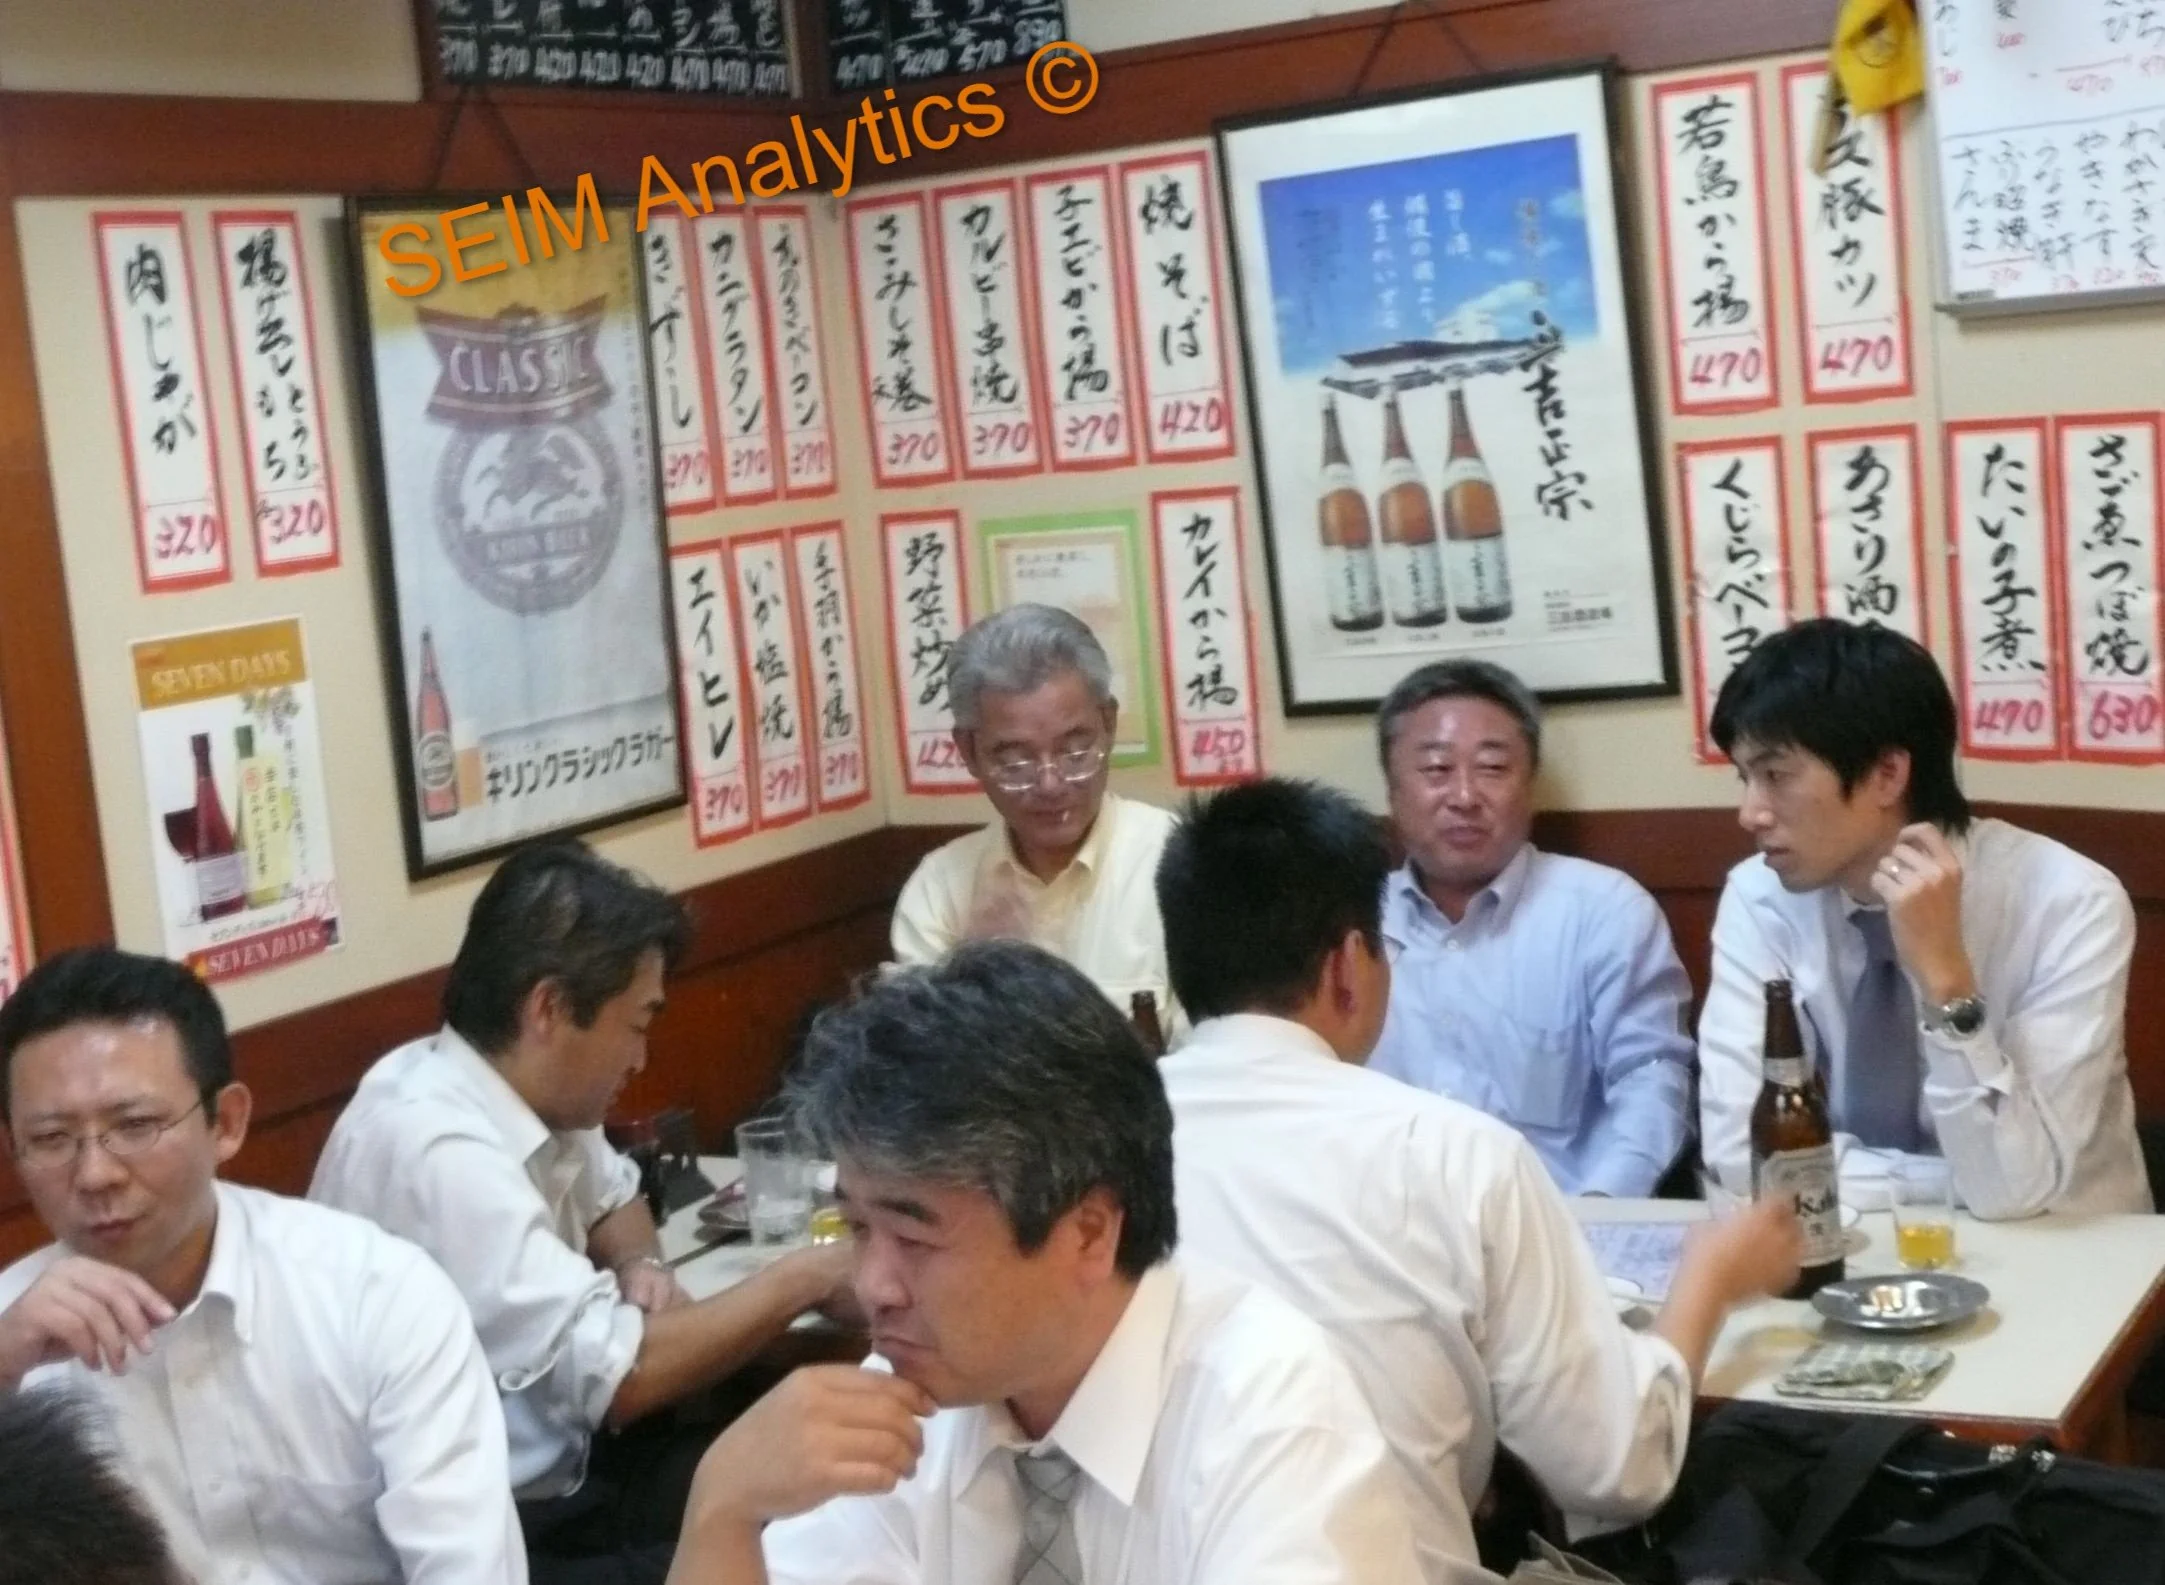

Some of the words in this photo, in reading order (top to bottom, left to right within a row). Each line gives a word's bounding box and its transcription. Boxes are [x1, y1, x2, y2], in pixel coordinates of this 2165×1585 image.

[1140, 178, 1209, 365] 焼そば
[125, 243, 197, 455] 肉じゃが
[710, 232, 761, 432] カニグラタン
[1821, 335, 1893, 377] 470
[449, 335, 590, 393] CLASSIC
[1689, 348, 1761, 387] 470
[973, 422, 1029, 456] 370
[1065, 412, 1118, 451] 370
[1161, 398, 1222, 440] 420
[888, 432, 938, 464] 370
[154, 513, 217, 558] 320
[1844, 445, 1899, 627] あさり酒
[1712, 458, 1769, 668] くじらベーコ
[1182, 513, 1238, 706] カレイから揚
[152, 661, 225, 698] SEVEN
[689, 567, 734, 758] エイヒレ
[1976, 698, 2044, 740] 470
[2089, 689, 2158, 740] 630
[486, 725, 675, 803] キリンクラシックラガー
[916, 742, 968, 769] 42
